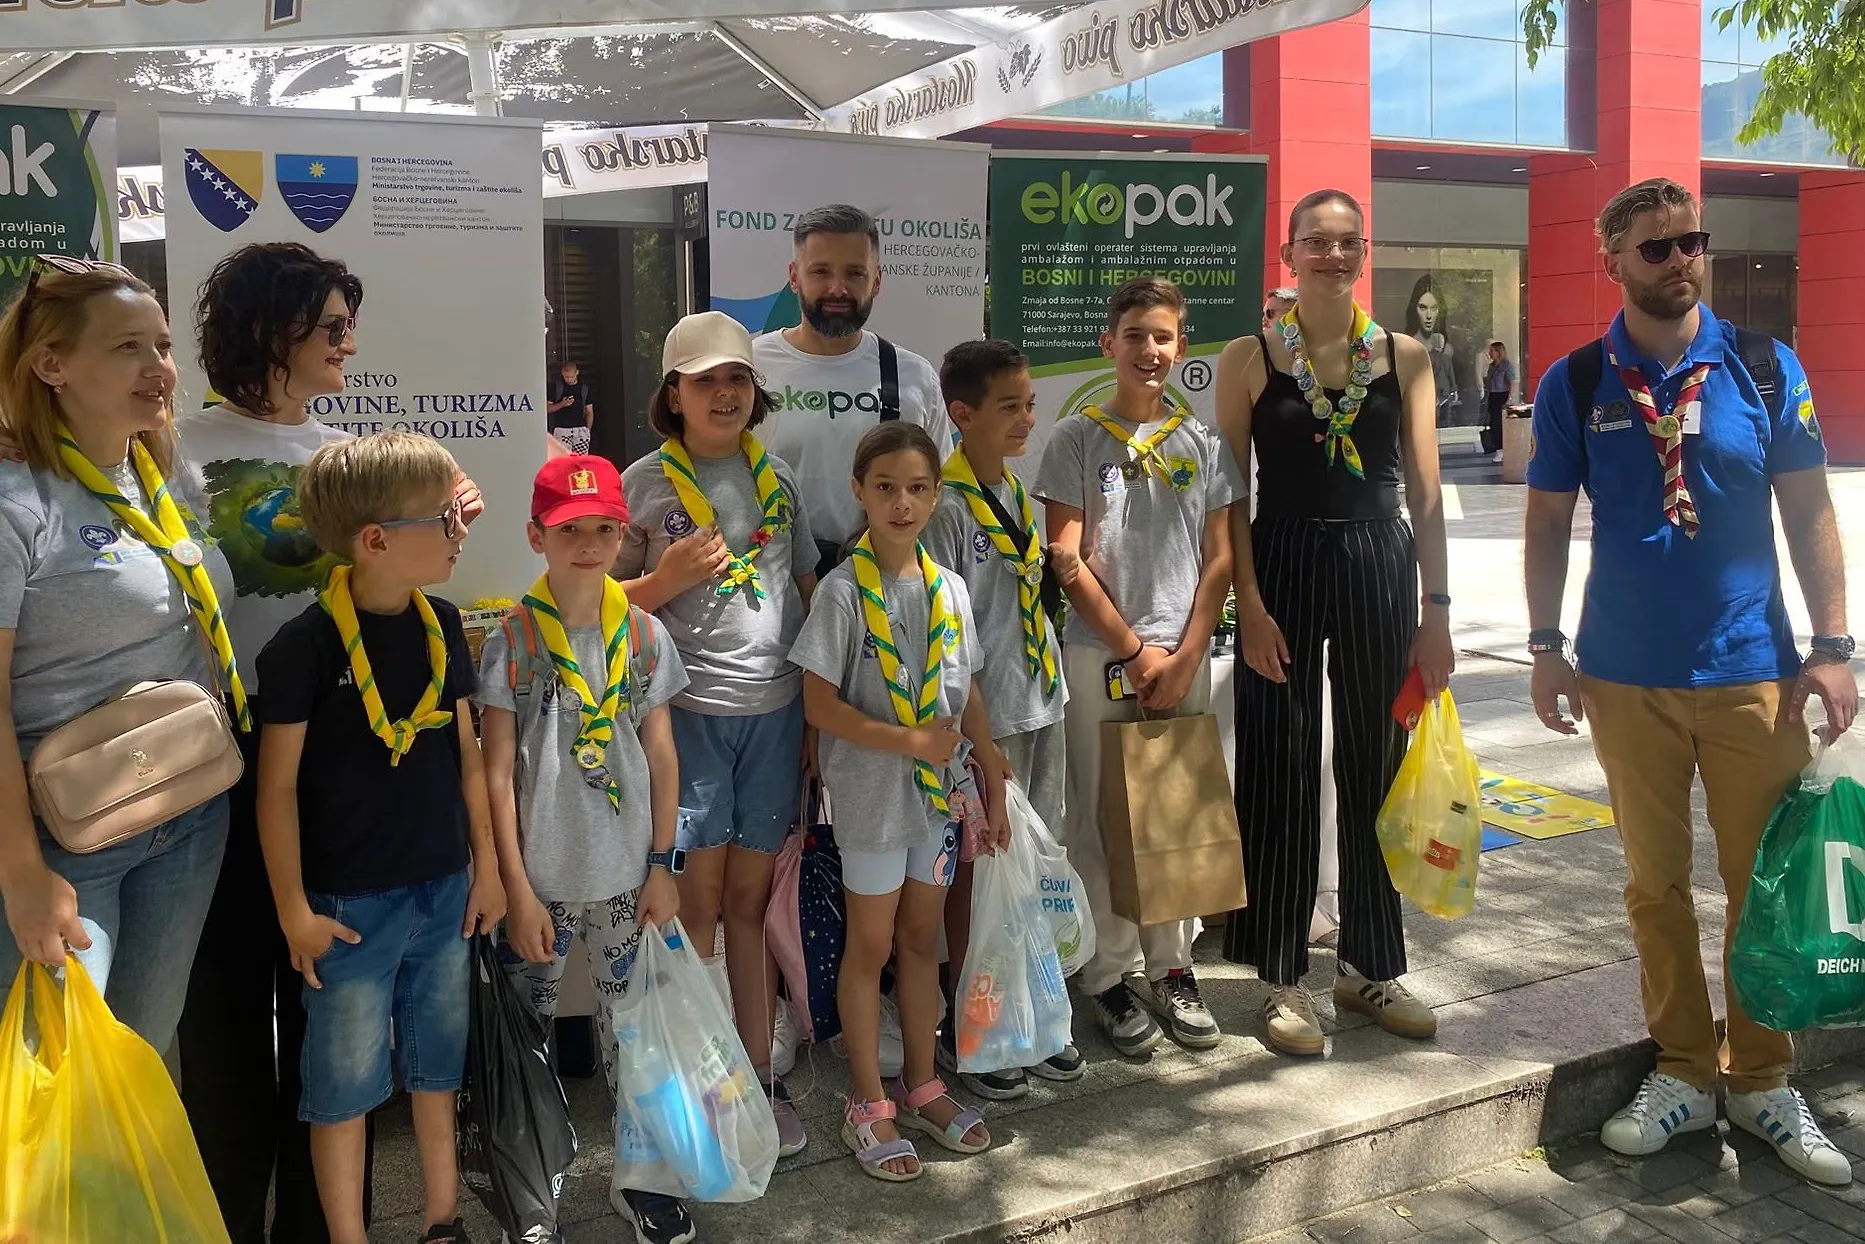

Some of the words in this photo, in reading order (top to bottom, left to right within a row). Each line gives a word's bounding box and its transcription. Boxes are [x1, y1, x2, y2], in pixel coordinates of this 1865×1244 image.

[402, 158, 453, 167] HERCEGOVINA
[372, 182, 414, 190] Ministarstvo
[1020, 170, 1234, 239] ekopak
[716, 210, 777, 231] FOND
[900, 217, 982, 240] OKOLIŠA
[57, 240, 67, 250] u
[884, 243, 980, 259] HERCEGOVAČKO-
[1021, 242, 1040, 253] prvi
[1046, 242, 1088, 252] ovlašteni
[1094, 243, 1134, 253] operater
[1140, 243, 1178, 252] sistema
[1183, 243, 1236, 255] upravljanja
[1021, 253, 1084, 264] ambalažom
[1101, 254, 1167, 265] ambalažnim
[1173, 255, 1223, 267] otpadom
[1229, 257, 1236, 265] u
[881, 263, 919, 277] ANSKE
[922, 262, 974, 280] ŽUPANIJE
[1022, 269, 1082, 285] BOSNI
[1089, 269, 1093, 285] I
[926, 284, 980, 297] KANTONA
[1022, 296, 1047, 307] Zmaja
[1048, 296, 1059, 305] od
[1060, 296, 1084, 305] Bosne
[1086, 296, 1105, 306] 7-7a,
[1183, 297, 1207, 305] tanne
[1208, 297, 1235, 305] centar
[1022, 311, 1046, 319] 71000
[1047, 310, 1082, 321] Sarajevo,
[1084, 311, 1108, 319] Bosna
[1022, 325, 1071, 333] Telefon:+387
[1072, 325, 1083, 333] 33
[1083, 325, 1098, 333] 921
[1100, 325, 1110, 333] 93
[344, 371, 397, 388] rstvo
[413, 393, 534, 413] TURIZMA
[768, 385, 882, 420] ekopa
[602, 945, 621, 961] NO
